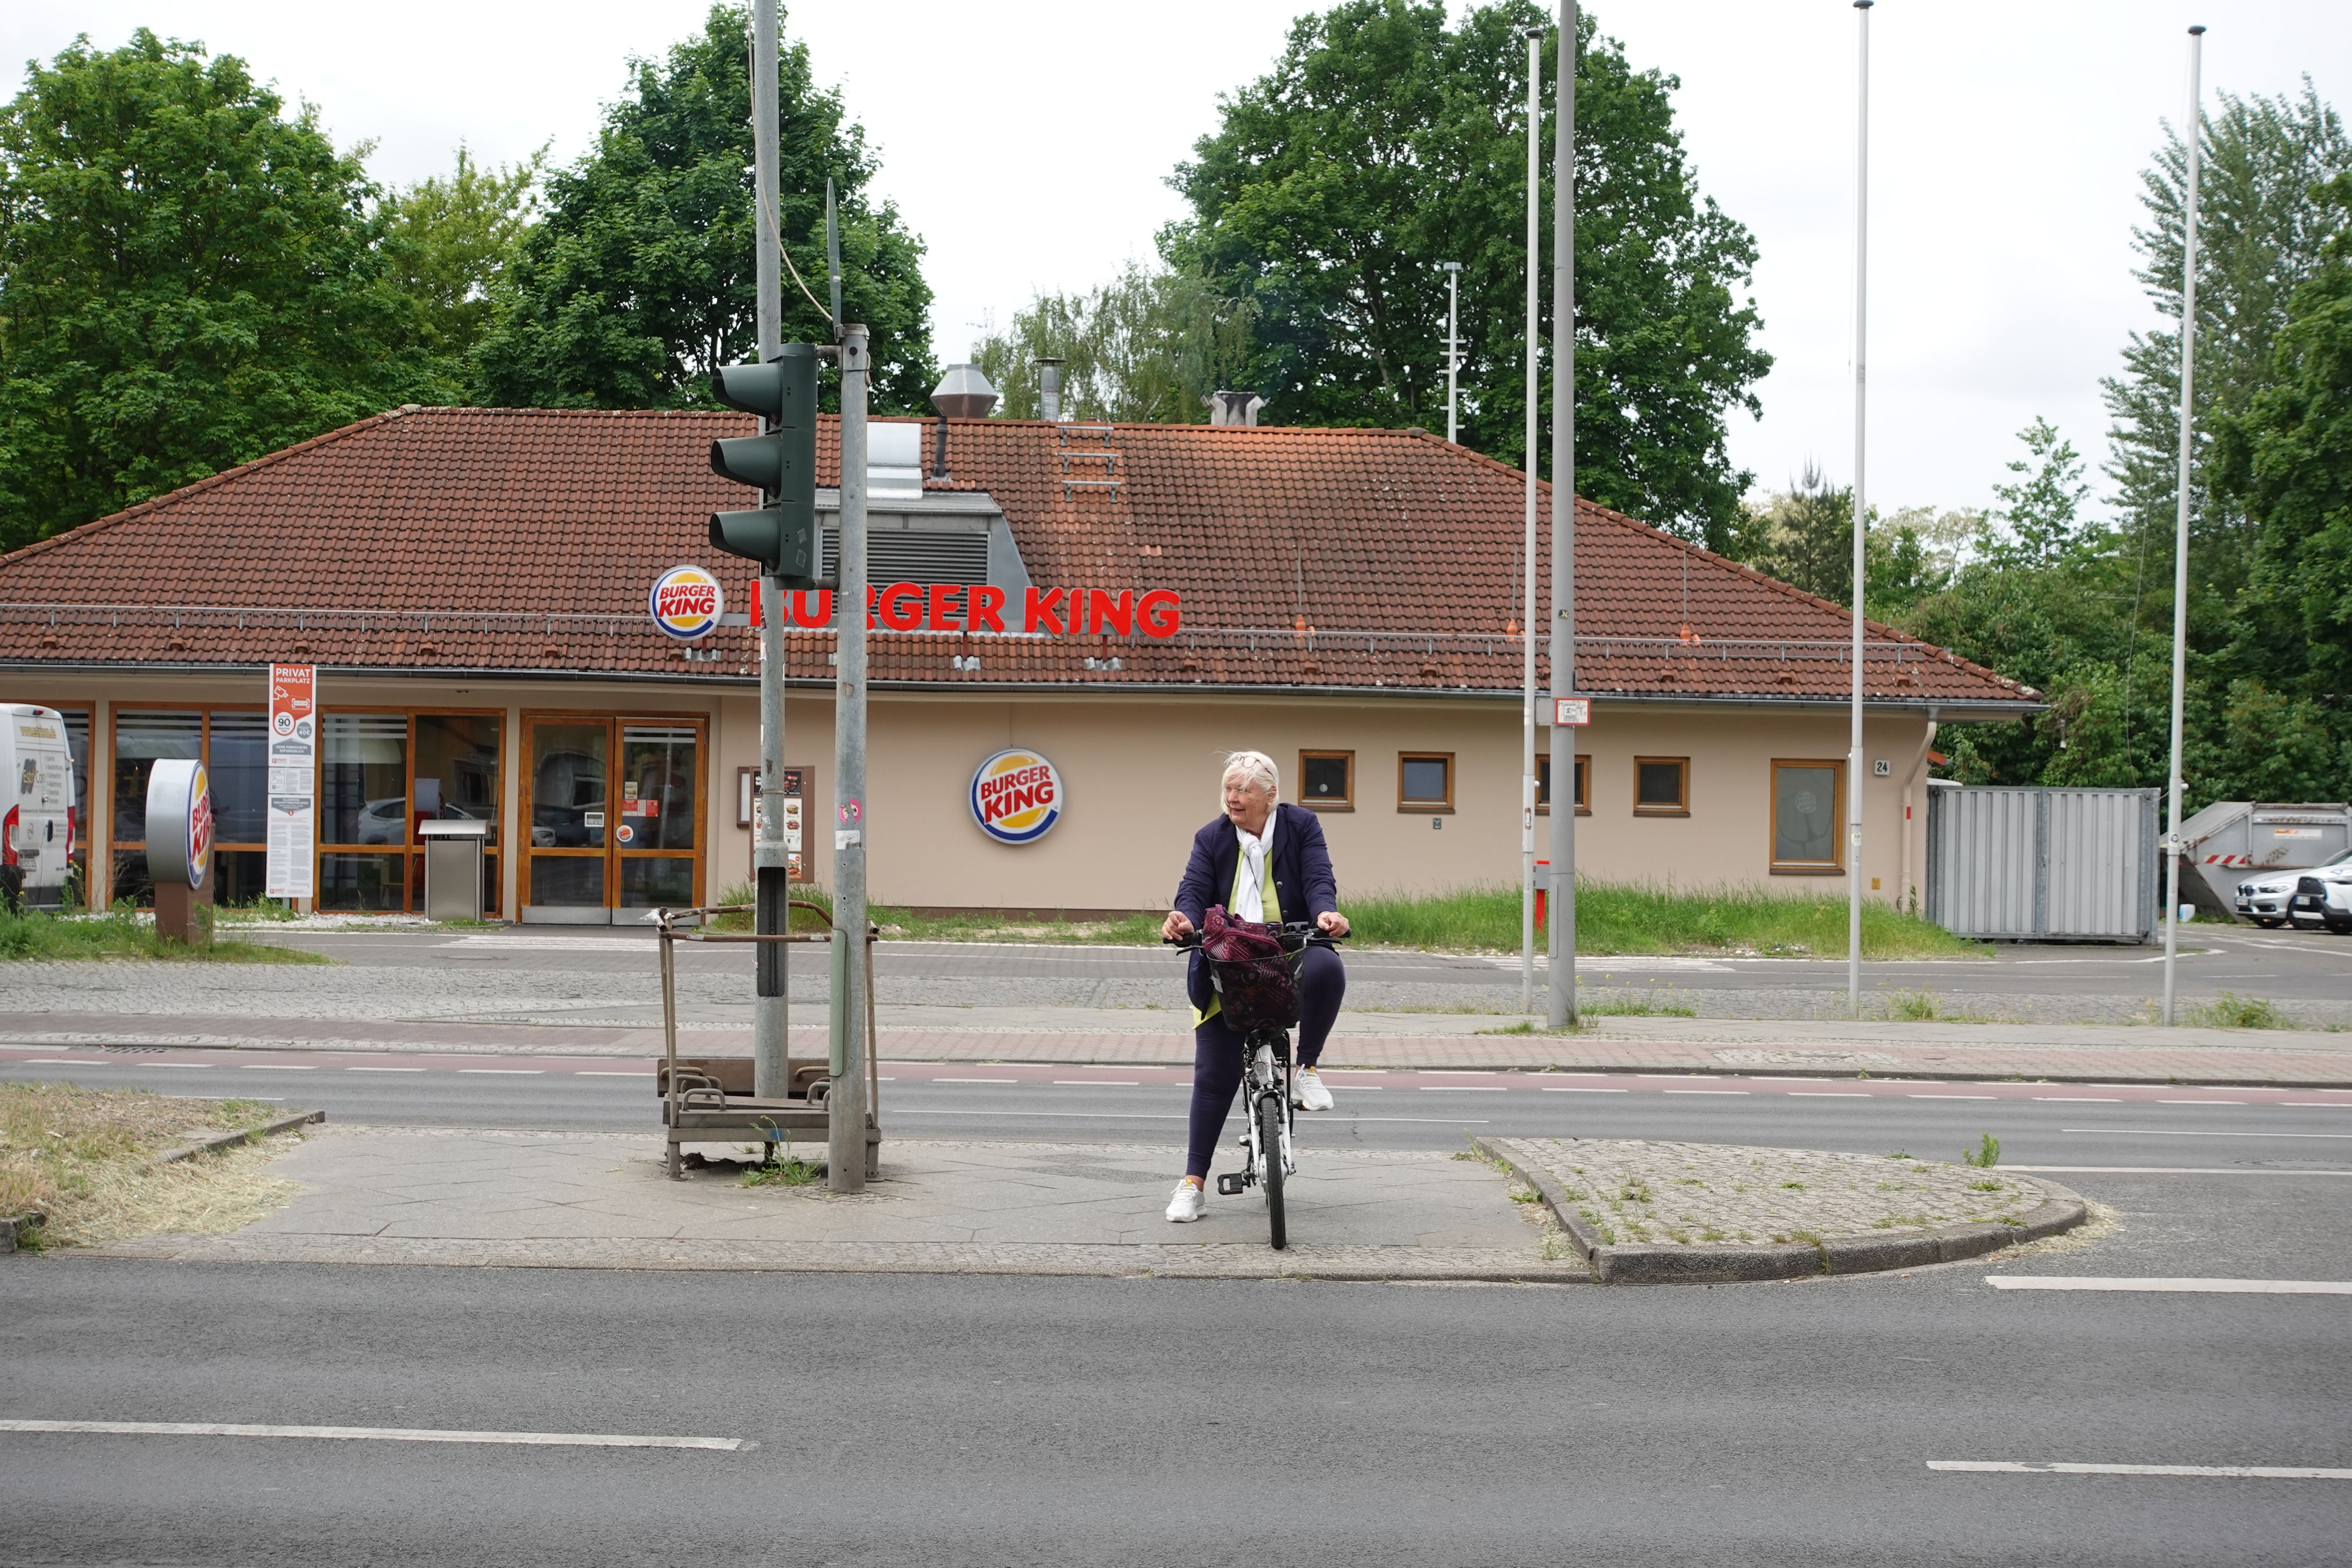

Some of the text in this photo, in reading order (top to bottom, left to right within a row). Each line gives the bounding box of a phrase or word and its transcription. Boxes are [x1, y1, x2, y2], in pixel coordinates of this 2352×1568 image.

[659, 585, 716, 600] BURGER
[658, 597, 716, 617] KING
[750, 580, 1180, 638] UGER KING
[276, 668, 311, 677] PRIVAT
[278, 718, 291, 726] 90
[1877, 762, 1887, 772] 24
[981, 765, 1050, 800] BURGER
[193, 789, 210, 833] BURG
[984, 781, 1054, 824] KING
[190, 815, 210, 864] KIN
